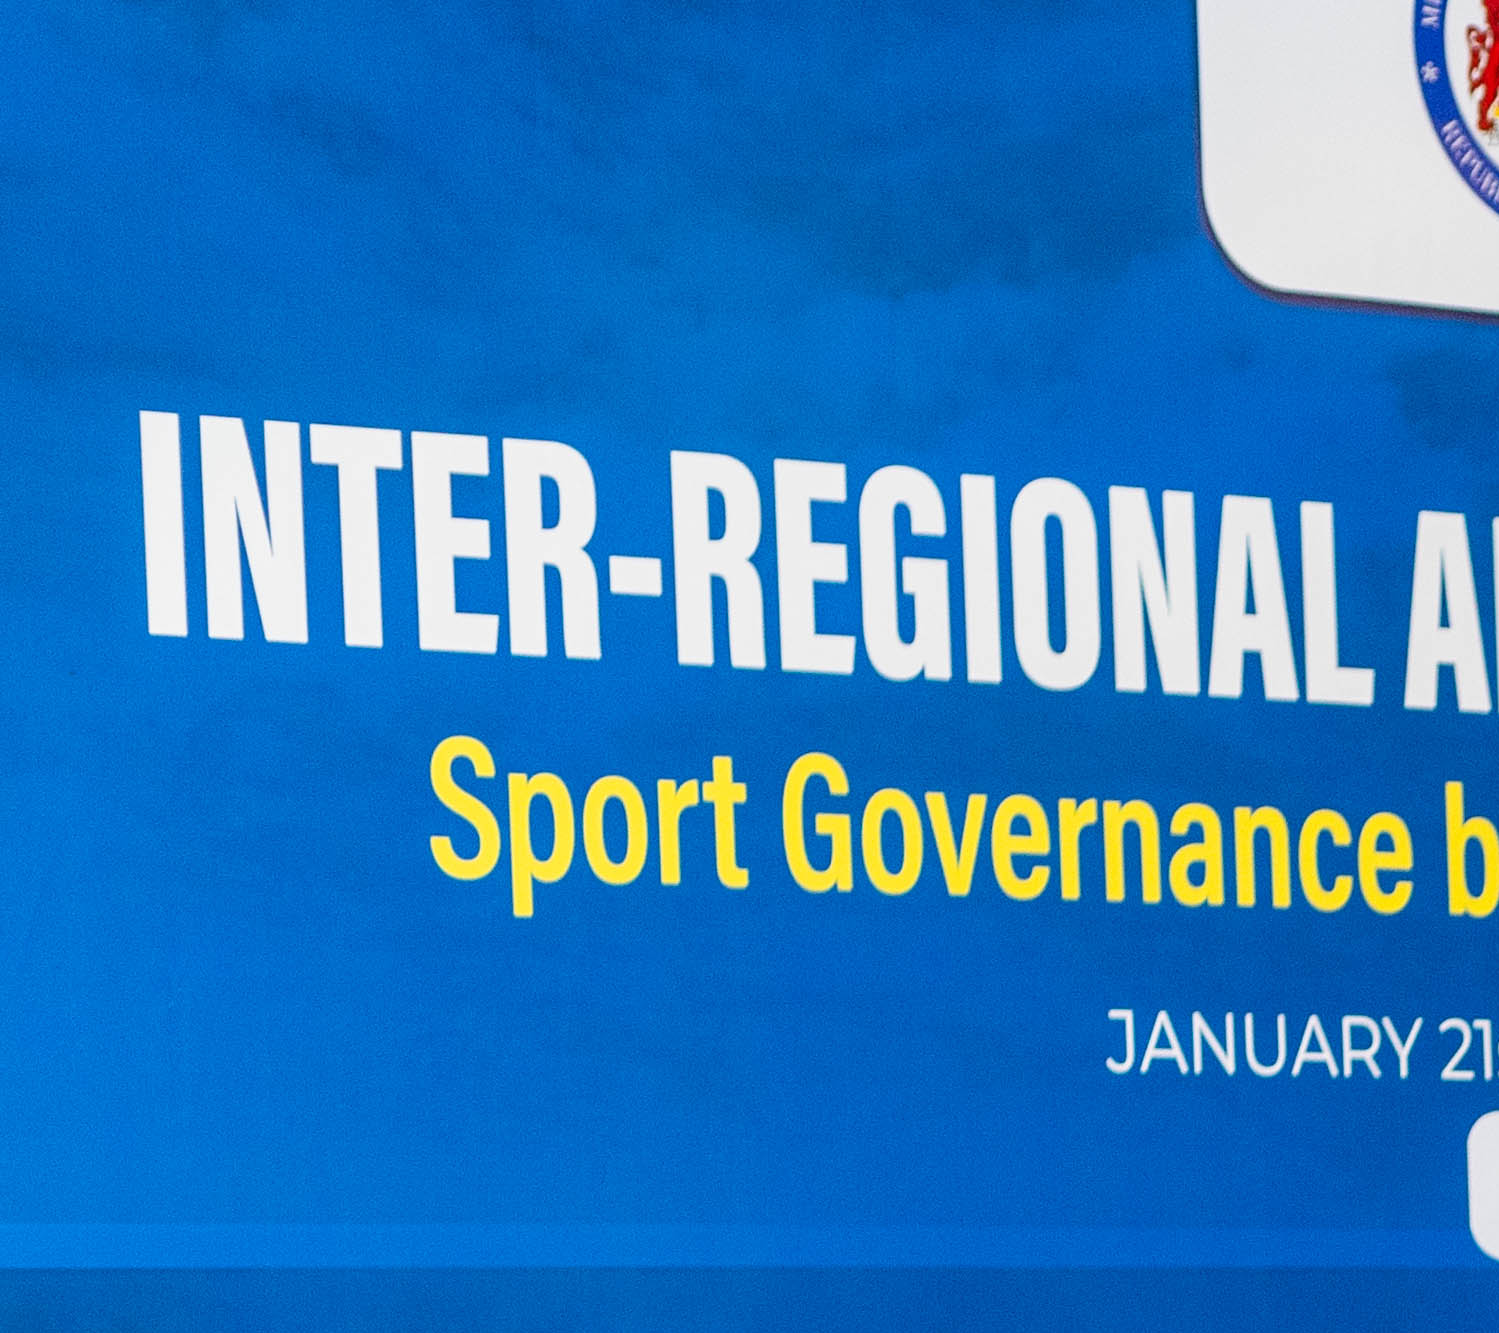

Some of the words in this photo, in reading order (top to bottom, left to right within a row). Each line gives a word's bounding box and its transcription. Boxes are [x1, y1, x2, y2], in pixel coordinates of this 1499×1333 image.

[139, 409, 1376, 708] INTER-REGIONAL
[431, 736, 749, 917] Sport
[783, 753, 1414, 915] Governance
[1106, 1009, 1422, 1079] JANUARY
